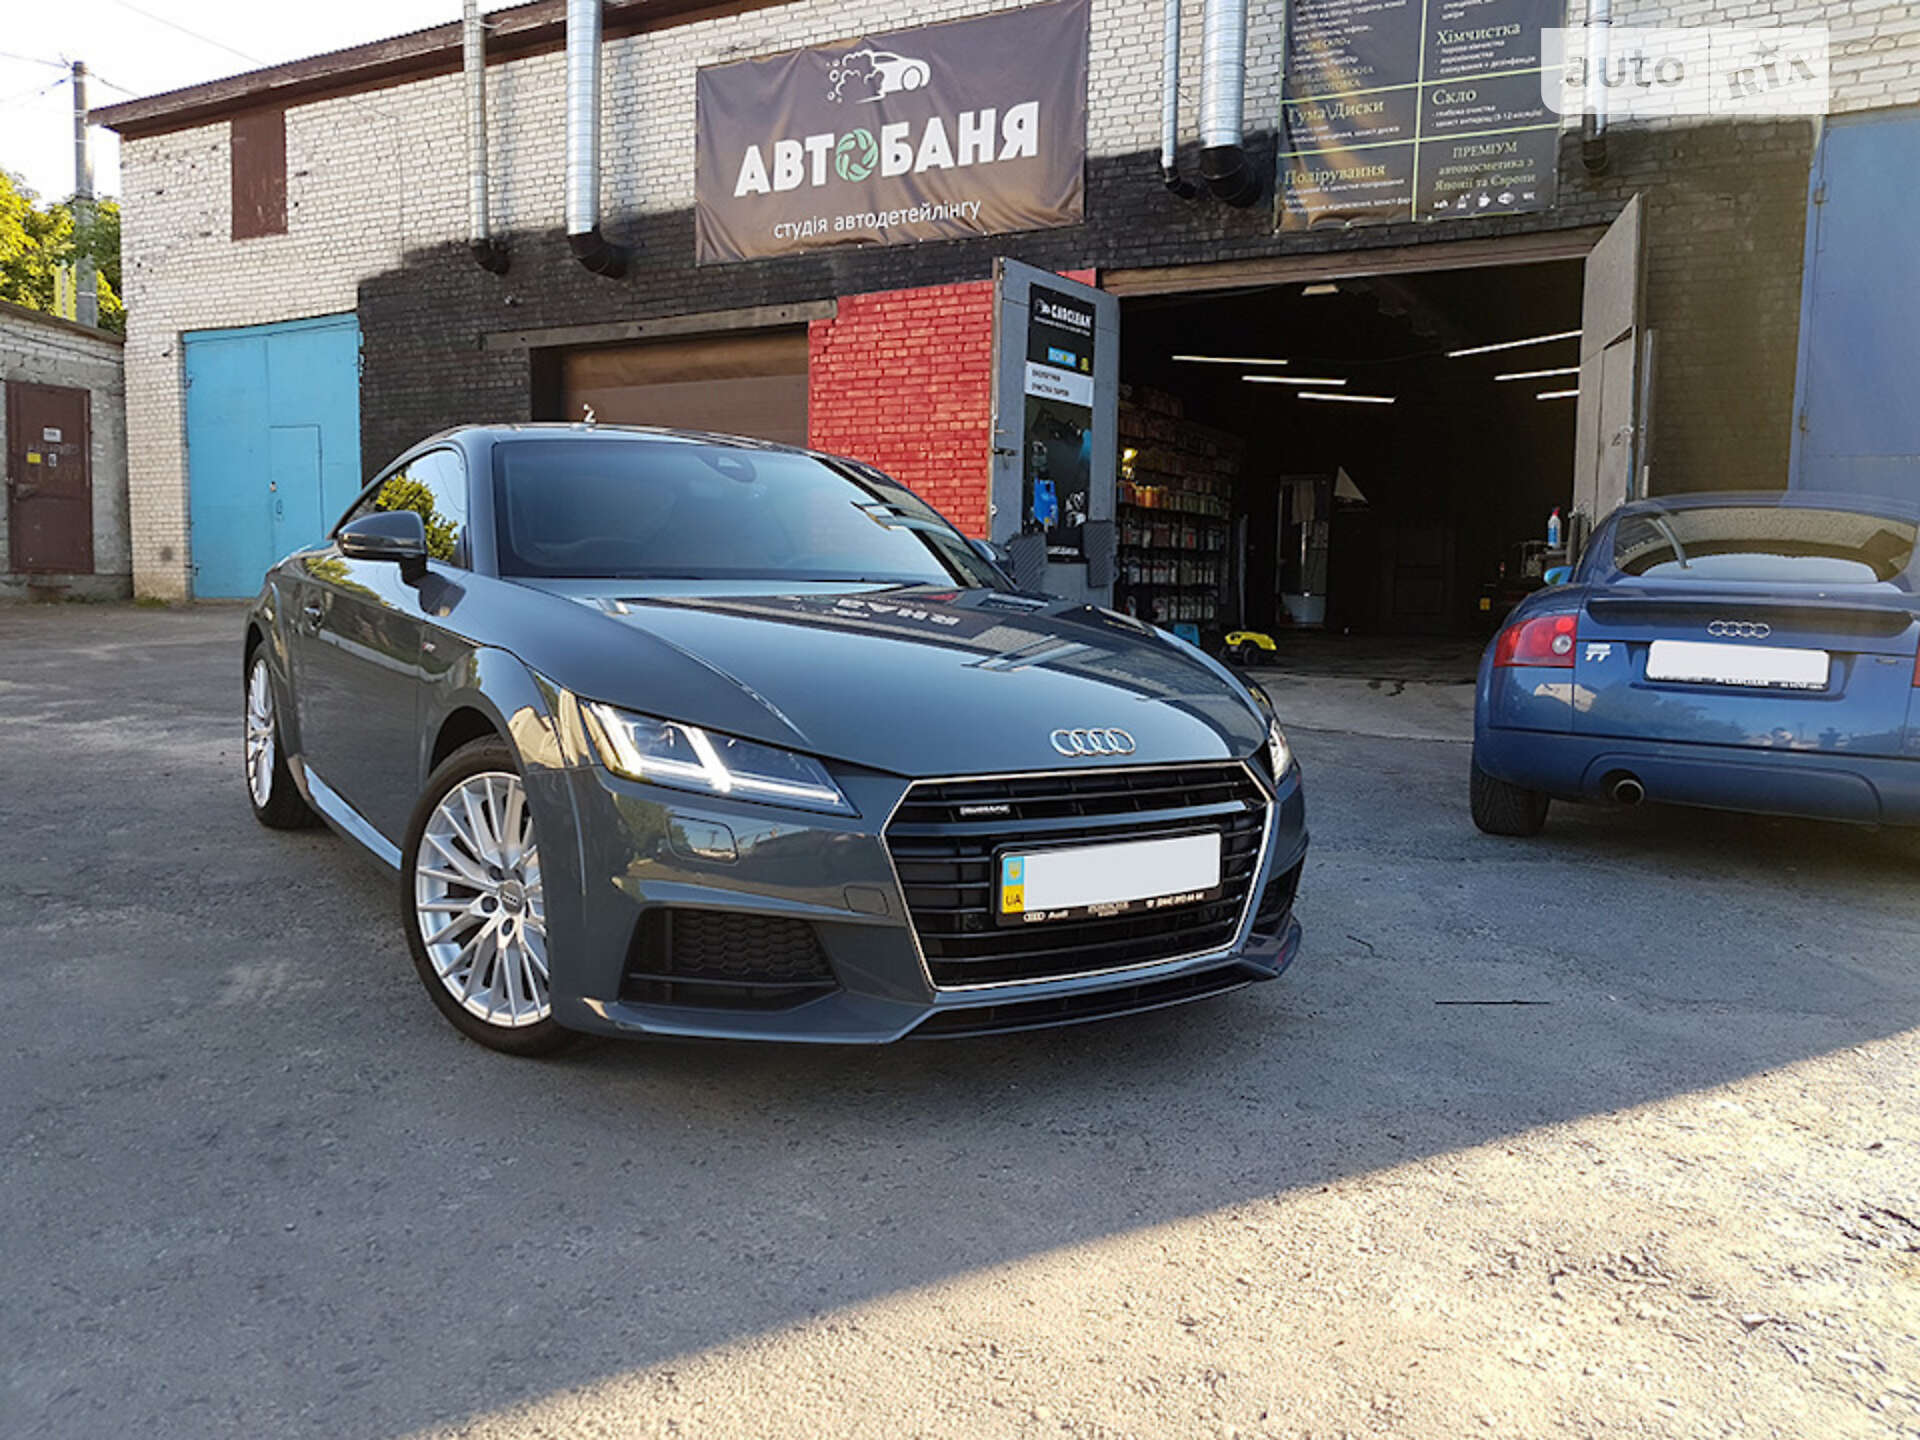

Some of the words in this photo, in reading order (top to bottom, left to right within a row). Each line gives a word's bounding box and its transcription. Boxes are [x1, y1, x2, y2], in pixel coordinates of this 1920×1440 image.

[1436, 23, 1520, 45] Хімчистка
[1432, 89, 1477, 105] Скло
[733, 101, 1040, 198] АВТОБАНЯ
[1453, 141, 1518, 159] ПРЕМІУМ
[774, 219, 828, 240] студія
[833, 200, 982, 232] автодетейлінгу
[1585, 643, 1612, 662] TT
[1005, 894, 1023, 906] UA
